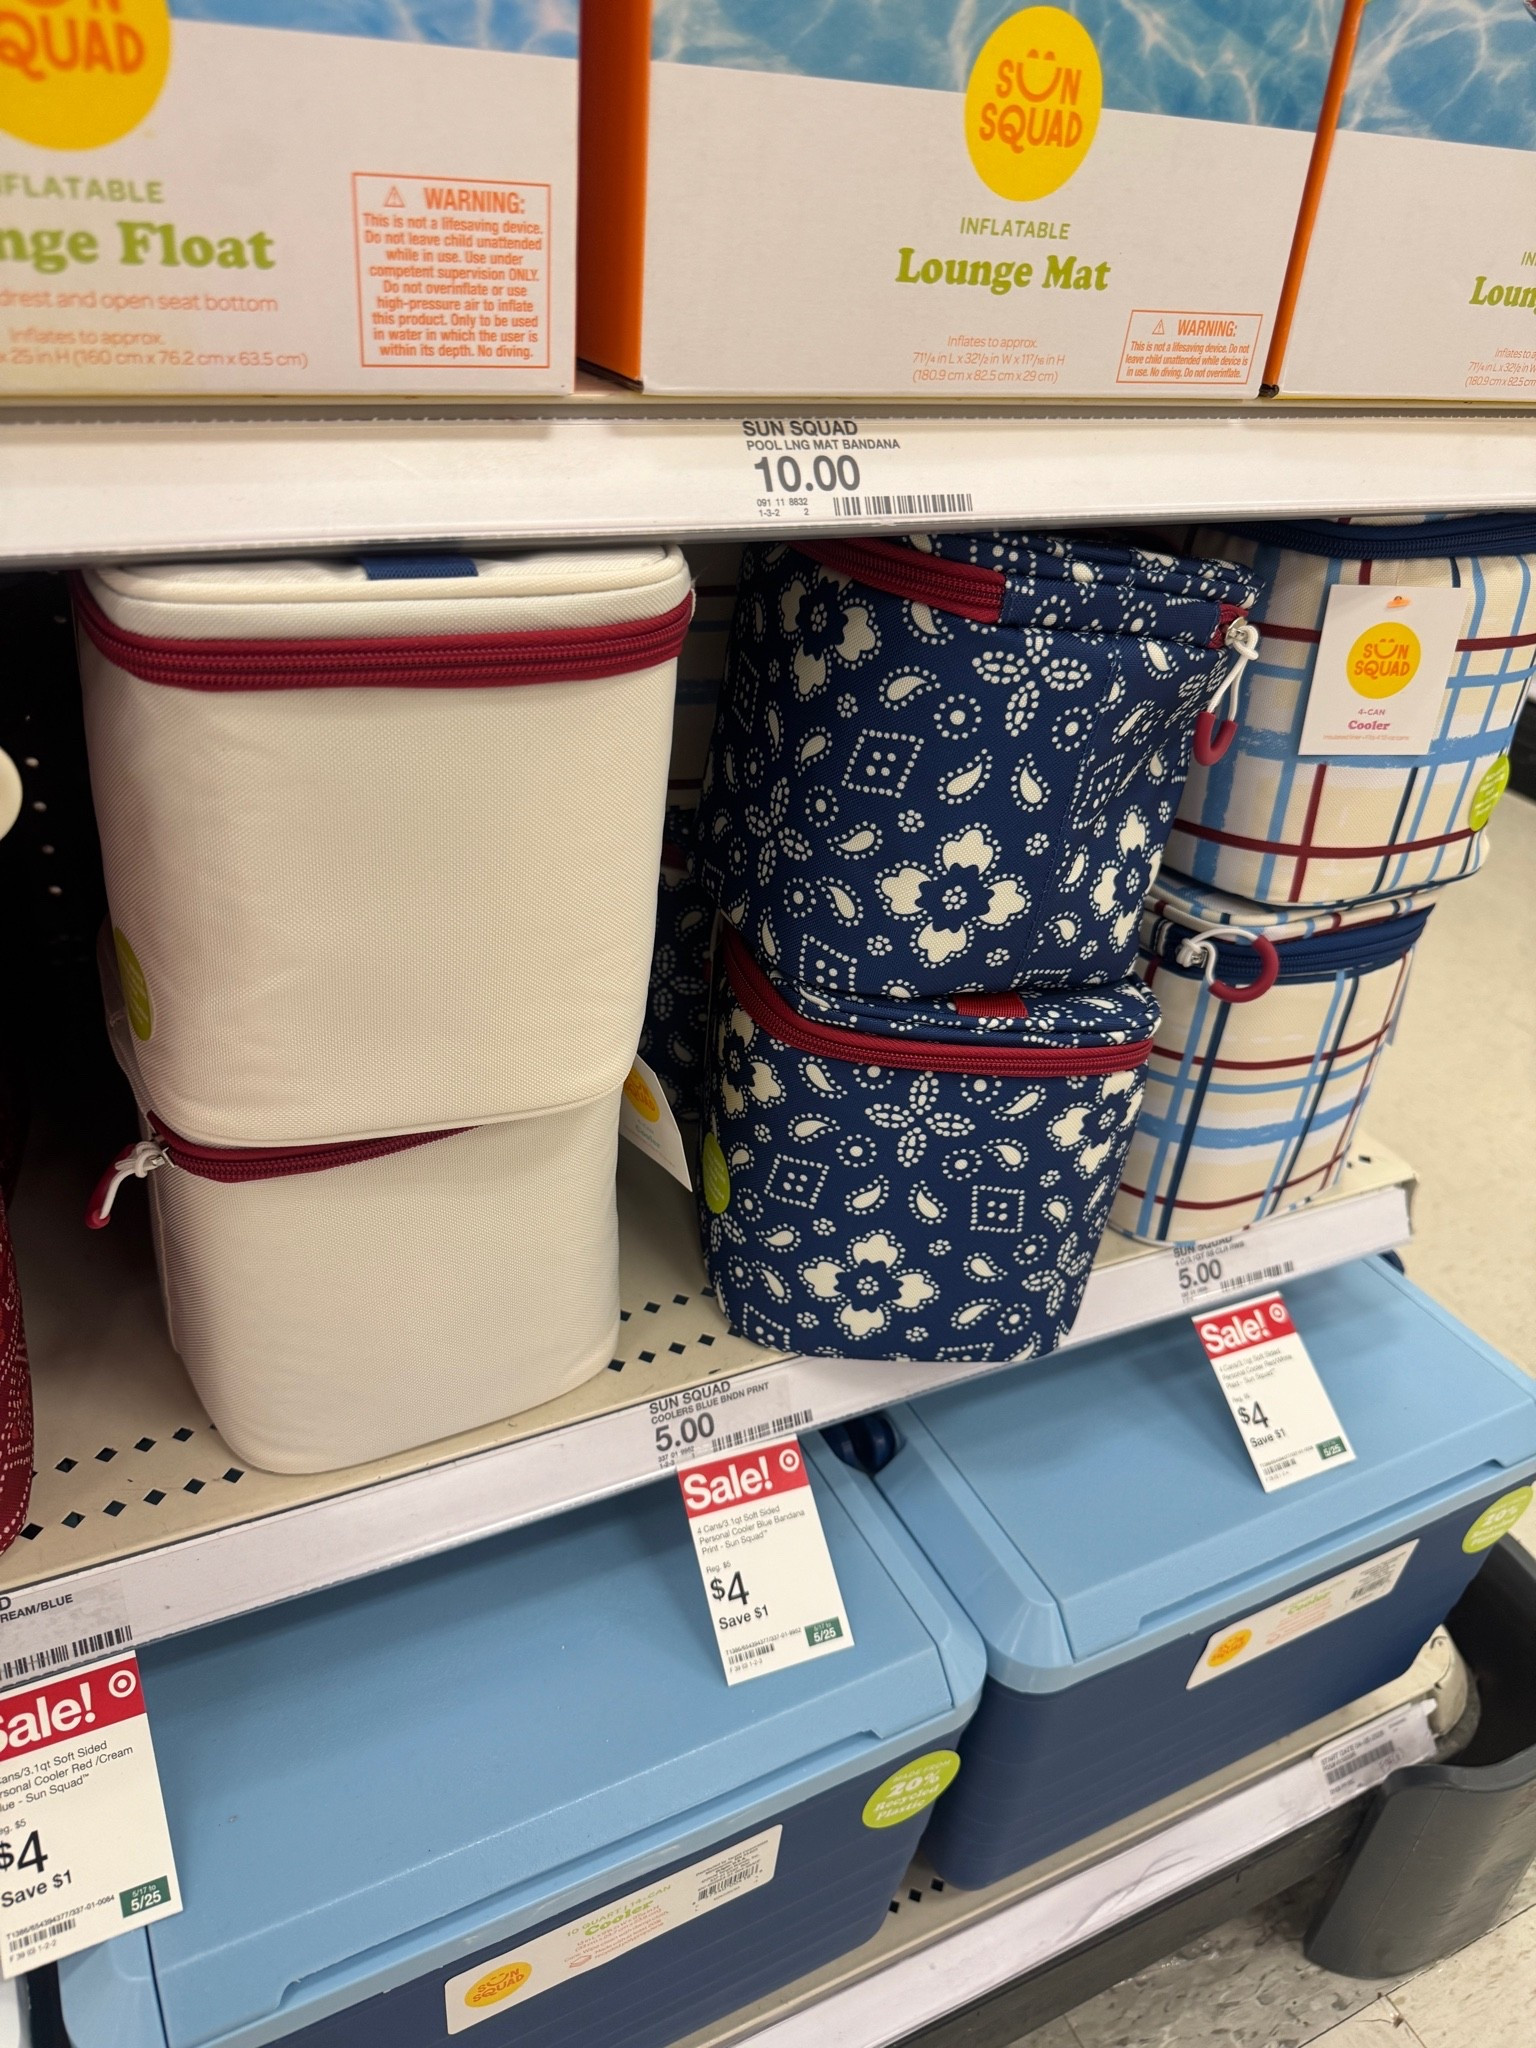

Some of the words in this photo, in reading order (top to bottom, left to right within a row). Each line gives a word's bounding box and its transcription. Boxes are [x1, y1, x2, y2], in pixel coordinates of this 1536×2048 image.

[996, 59, 1082, 105] SUN
[979, 102, 1082, 154] SQUAD
[0, 173, 163, 203] FLATABLE
[424, 187, 525, 214] WARNING:
[363, 213, 389, 227] This
[394, 215, 403, 228] is
[408, 217, 427, 229] not
[442, 217, 498, 234] lifesaving
[503, 221, 543, 235] device.
[960, 217, 1071, 239] INFLATABLE
[117, 220, 276, 270] Float
[365, 231, 381, 244] Do
[385, 232, 405, 244] not
[409, 233, 440, 246] leave
[444, 234, 473, 247] child
[477, 236, 541, 250] unattended
[386, 248, 419, 261] while
[423, 250, 433, 261] in
[438, 251, 462, 263] use.
[465, 251, 486, 263] Use
[490, 252, 523, 265] under
[369, 266, 434, 281] competent
[438, 268, 505, 283] supervision
[509, 269, 539, 281] ONLY.
[895, 247, 1033, 295] Lounge
[1042, 255, 1111, 291] Mat
[383, 280, 399, 293] Do
[403, 282, 422, 294] not
[426, 282, 488, 295] overinflate
[492, 284, 502, 295] or
[507, 286, 527, 296] use
[1469, 275, 1536, 315] Loun
[102, 293, 153, 312] open
[158, 294, 201, 311] seat
[206, 294, 278, 313] bottom
[377, 296, 461, 311] high-pressure
[464, 300, 479, 310] air
[483, 300, 494, 311] to
[498, 300, 534, 312] inflate
[372, 313, 394, 325] this
[399, 314, 447, 328] product.
[451, 315, 476, 329] Only
[480, 315, 490, 326] to
[495, 315, 507, 327] be
[512, 316, 538, 327] used
[1177, 320, 1237, 337] WARNING:
[388, 329, 421, 340] water
[440, 329, 474, 342] which
[479, 330, 497, 342] the
[501, 333, 524, 342] user
[948, 335, 985, 347] Inflates
[988, 338, 998, 347] to
[379, 344, 416, 356] within
[421, 345, 435, 356] its
[439, 345, 474, 358] depth.
[478, 345, 492, 357] No
[496, 345, 533, 360] diving.
[1131, 341, 1144, 350] This
[1154, 343, 1165, 351] not
[1172, 343, 1202, 353] lifesaving
[1205, 344, 1227, 353] device.
[1229, 344, 1238, 353] Do
[1239, 345, 1249, 353] not
[1126, 355, 1144, 364] leave
[1145, 355, 1161, 364] child
[1163, 355, 1200, 365] unattended
[1202, 356, 1219, 365] while
[1220, 357, 1240, 365] device
[913, 370, 945, 382] (180.9
[948, 372, 964, 380] cm
[974, 370, 996, 381] 82.5
[998, 373, 1014, 381] cm
[1023, 371, 1036, 381] 29
[1038, 372, 1058, 383] cm)
[1151, 368, 1159, 376] No
[1184, 368, 1193, 377] Do
[1196, 369, 1205, 377] not
[743, 421, 785, 436] SUN
[790, 421, 857, 436] SQUAD
[747, 440, 782, 450] POOL
[785, 440, 810, 450] LNG
[814, 440, 838, 450] MAT
[842, 439, 900, 449] BANDANA
[754, 455, 860, 492] 10.00
[789, 498, 808, 506] 8832
[759, 509, 780, 517] 1-3-2
[1363, 643, 1409, 659] SUN
[1354, 661, 1410, 679] SQUAD
[1348, 720, 1390, 730] Cooler
[1179, 1259, 1221, 1289] 5.00
[1201, 1309, 1271, 1353] Sale!
[649, 1396, 679, 1415] SUN
[682, 1381, 731, 1405] SQUAD
[651, 1407, 694, 1424] COOLERS
[696, 1398, 719, 1411] BLUE
[720, 1389, 745, 1404] BNDN
[747, 1382, 769, 1395] PRNT
[1238, 1400, 1269, 1428] $4
[655, 1412, 714, 1451] 5.00
[1250, 1431, 1274, 1448] Save
[1275, 1428, 1286, 1439] $1
[1324, 1444, 1342, 1457] 5/25
[684, 1456, 773, 1510] Sale!
[744, 1512, 758, 1521] Soft
[760, 1506, 780, 1516] Sided
[700, 1531, 730, 1544] Personal
[732, 1524, 755, 1535] Cooler
[757, 1517, 772, 1528] Blue
[774, 1510, 805, 1523] Bandana
[702, 1545, 718, 1554] Print
[726, 1540, 739, 1549] Sun
[711, 1571, 749, 1605] $4
[0, 1594, 73, 1623] REAM/BLUE
[719, 1612, 751, 1629] Save
[754, 1605, 769, 1619] $1
[814, 1628, 836, 1642] 5/25
[54, 1752, 74, 1766] Soft
[78, 1741, 107, 1757] Sided
[34, 1768, 68, 1786] Cooler
[72, 1759, 93, 1773] Red
[96, 1747, 133, 1765] /Cream
[888, 1770, 940, 1798] 20%
[26, 1790, 46, 1803] Sun
[15, 1819, 26, 1828] $5
[0, 1830, 49, 1874] $4
[2, 1882, 47, 1908] Save
[53, 1870, 72, 1888] $1
[131, 1890, 161, 1911] 5/25
[585, 1900, 653, 1935] Cooler
[473, 1974, 524, 2002] SQUAD
[478, 1968, 519, 1992] SUN
